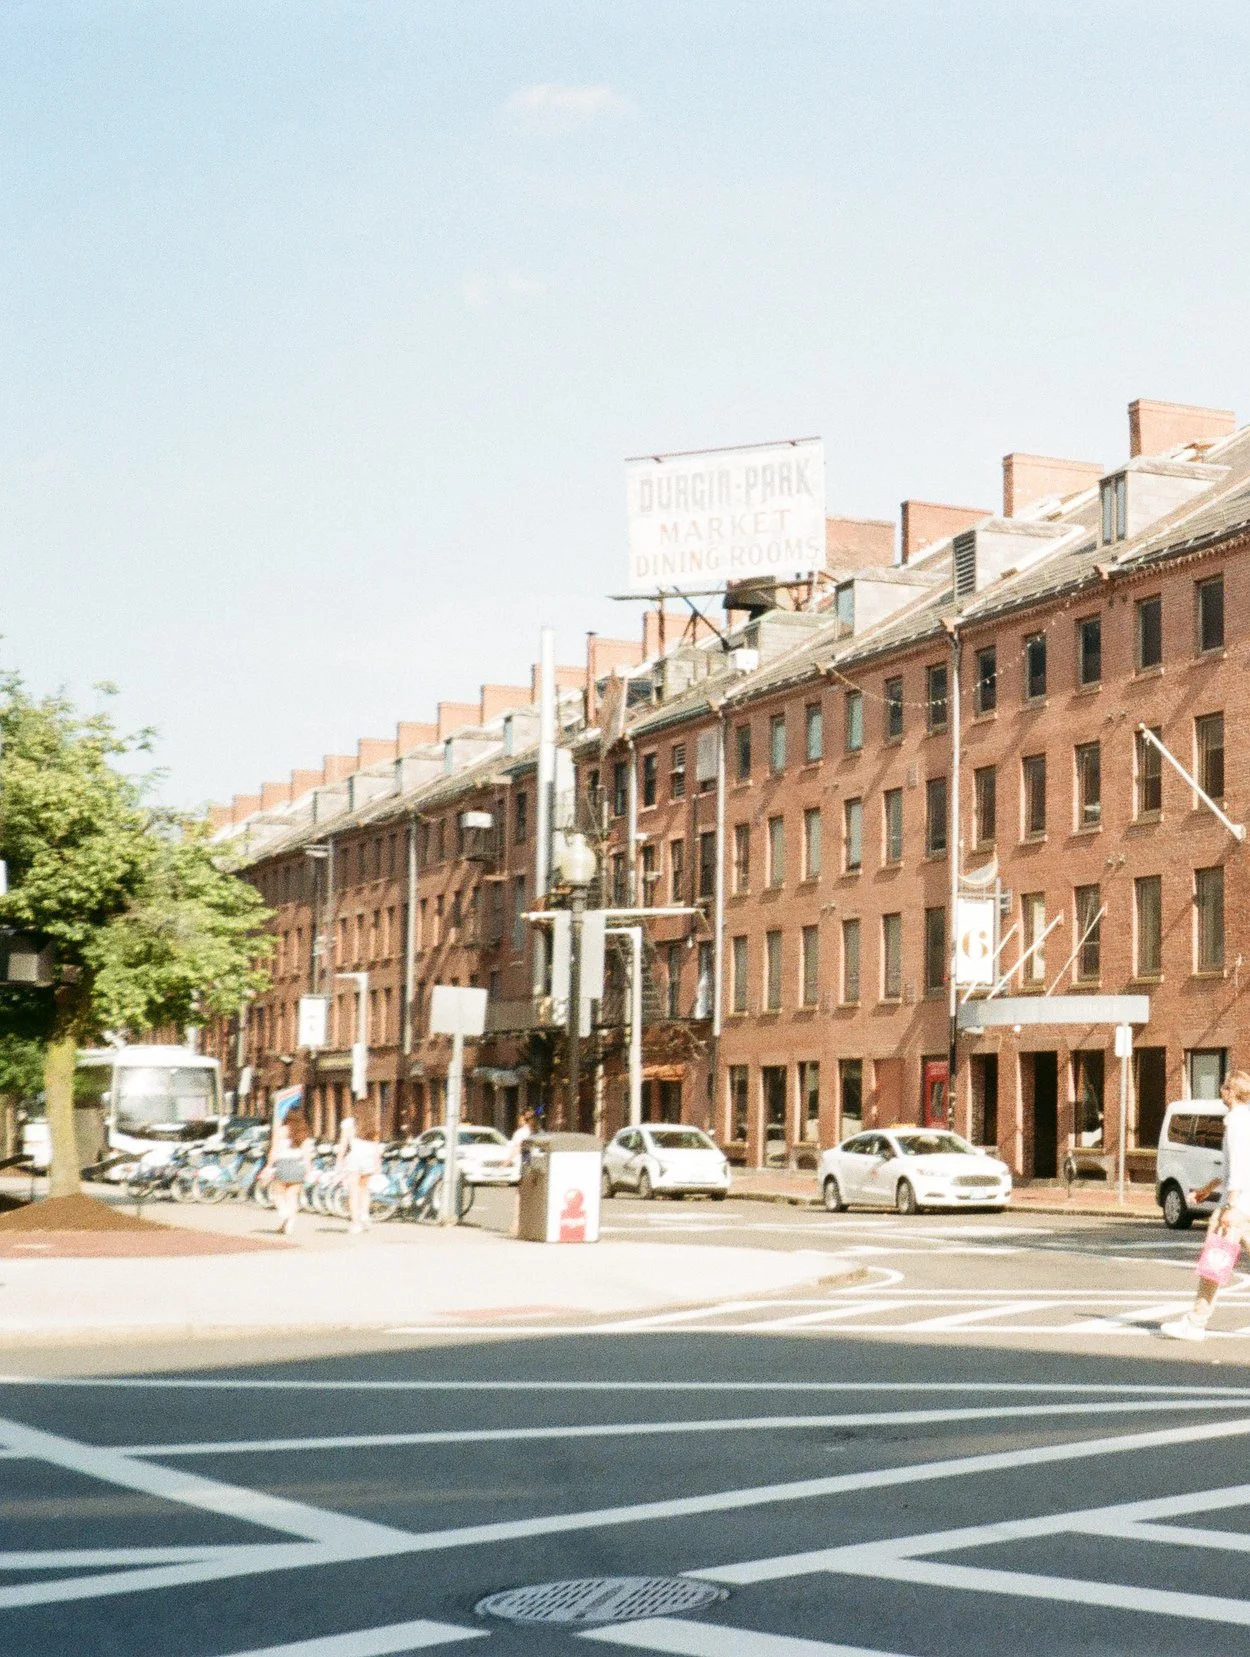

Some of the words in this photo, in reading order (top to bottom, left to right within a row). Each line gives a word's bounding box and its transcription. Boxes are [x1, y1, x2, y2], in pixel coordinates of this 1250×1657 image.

[658, 508, 792, 546] MARKET
[635, 547, 720, 578] DINING
[730, 537, 820, 567] ROOMS
